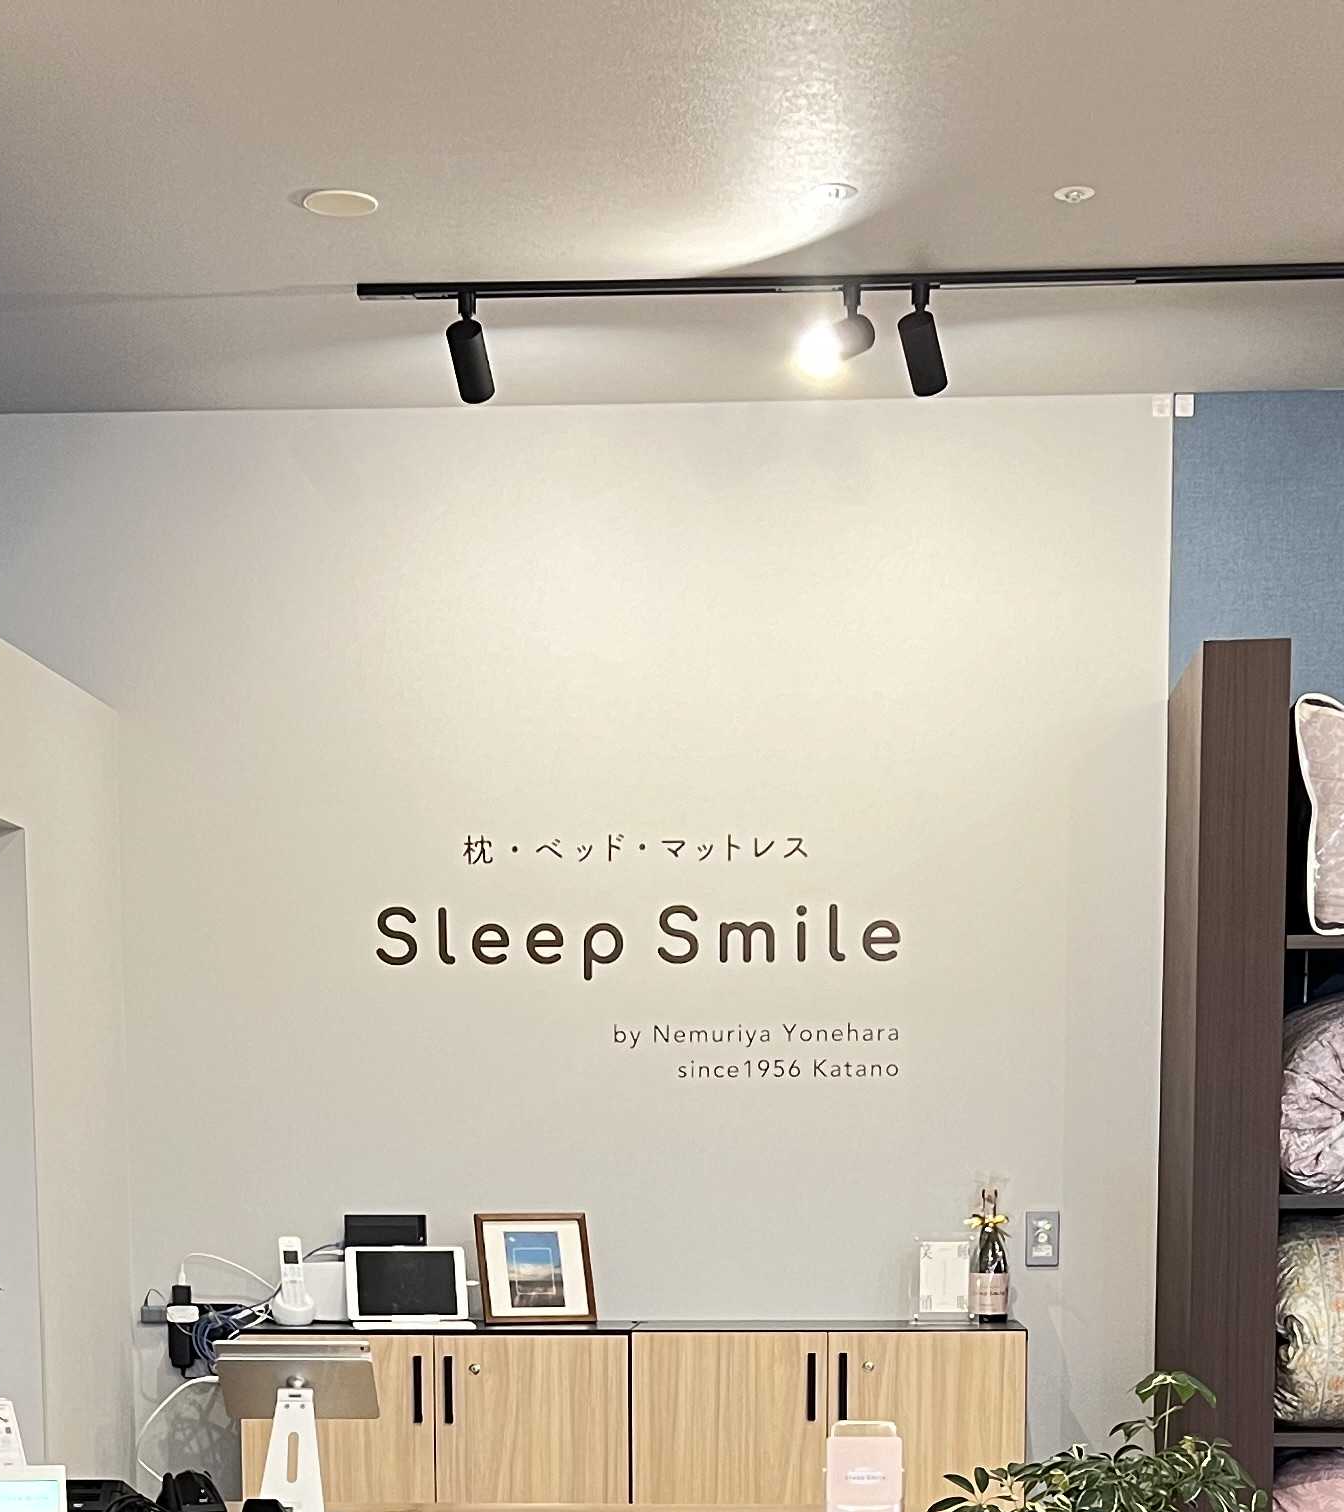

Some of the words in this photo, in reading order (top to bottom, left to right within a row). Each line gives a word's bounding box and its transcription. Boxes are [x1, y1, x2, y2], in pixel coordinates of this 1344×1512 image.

[463, 833, 809, 865] 枕・ベッド・マットレス
[375, 906, 624, 981] Sleep
[657, 903, 902, 965] Smile
[613, 1023, 641, 1049] by
[653, 1023, 772, 1049] Nemuriya
[782, 1021, 899, 1042] Yonehara
[677, 1059, 801, 1079] since1956
[813, 1058, 899, 1078] Katano
